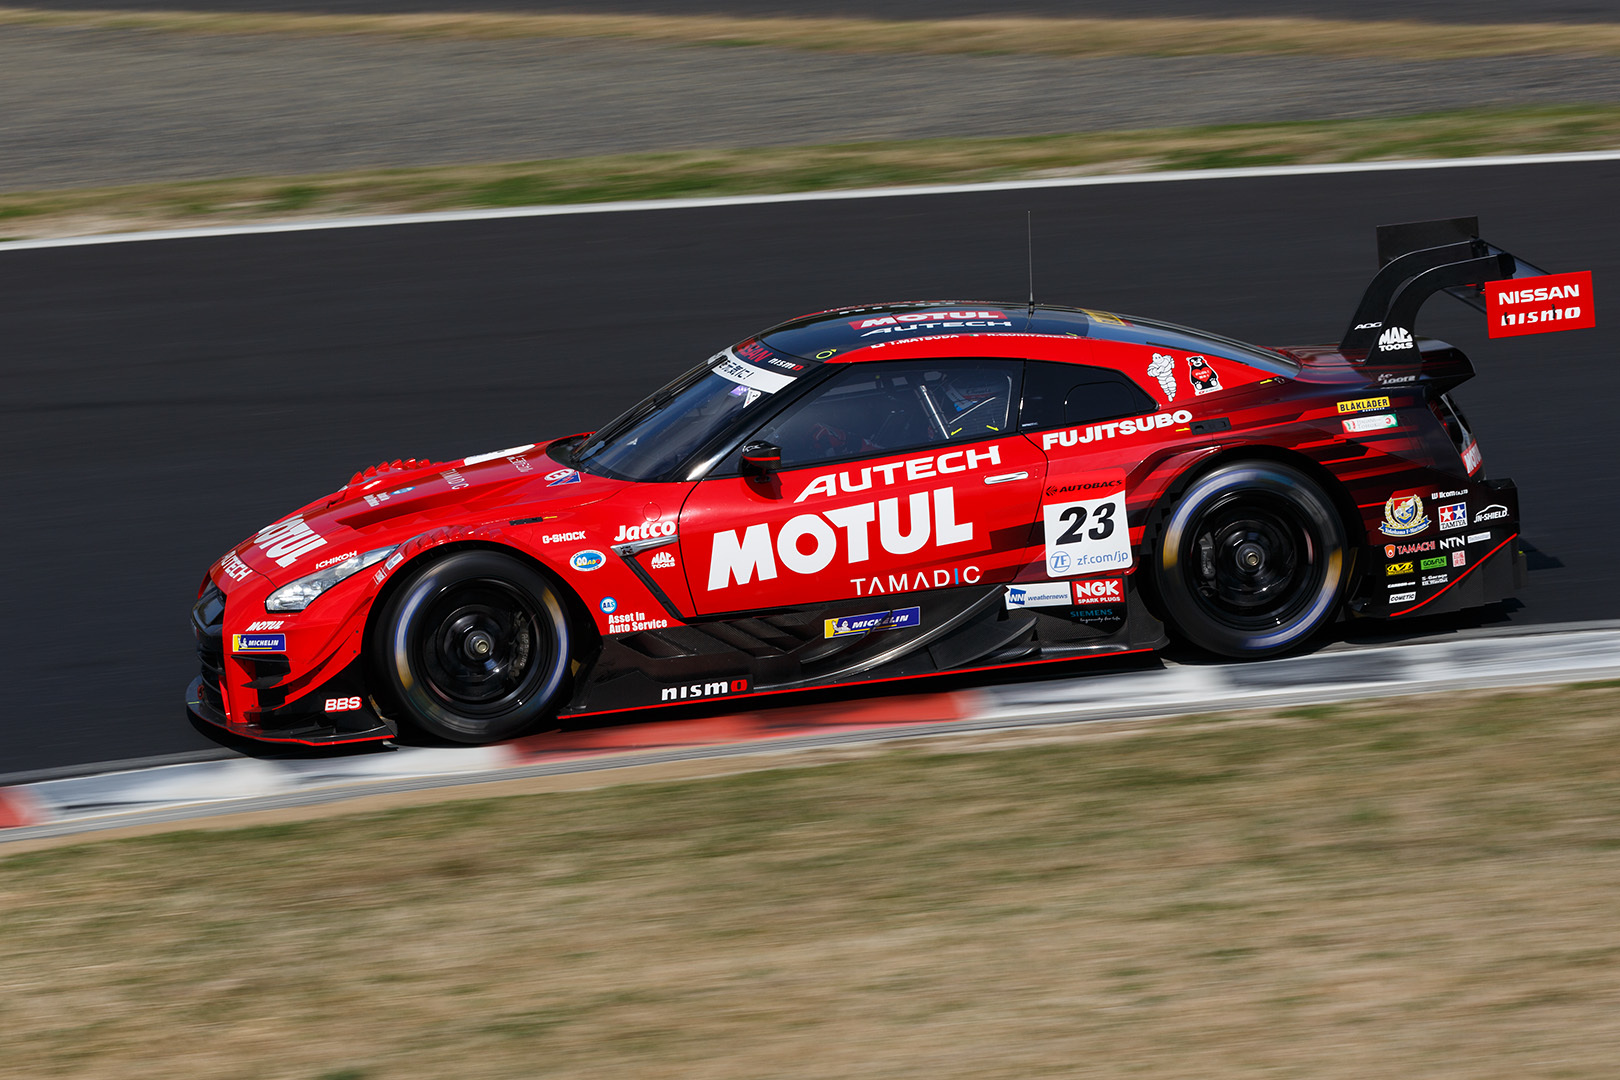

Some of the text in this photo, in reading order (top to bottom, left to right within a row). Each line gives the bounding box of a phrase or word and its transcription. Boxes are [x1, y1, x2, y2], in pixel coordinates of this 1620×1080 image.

[1498, 284, 1580, 305] NISSAN
[860, 311, 999, 328] MOTUL
[1501, 307, 1581, 326] nismo
[860, 321, 1012, 337] AUTECH
[1378, 327, 1413, 345] MAC
[1379, 342, 1413, 352] TOOLS
[1042, 409, 1193, 450] FUJITSUBO
[793, 445, 1001, 503] AUTECH
[1059, 480, 1122, 493] AUTOBACS
[614, 520, 676, 542] Jatco
[1056, 502, 1116, 545] 23
[1440, 519, 1467, 529] TAMIYA
[542, 530, 586, 544] G-SHOCK
[707, 486, 973, 592] MOTUL
[1440, 535, 1465, 549] NTN
[1397, 541, 1436, 555] TAMACHI
[315, 550, 357, 570] ICHIKOH
[1053, 551, 1129, 569] ZF zf.com/jp
[850, 566, 981, 596] TAMADIC
[1076, 580, 1119, 598] NGK
[602, 601, 615, 609] AAS
[1028, 594, 1068, 602] weathernews
[608, 613, 634, 624] Asset
[1070, 609, 1113, 618] SIEMENS
[245, 621, 284, 632] MOTUL
[609, 619, 667, 634] Auto Service
[852, 614, 909, 630] MICHELIN
[661, 679, 748, 701] nismo
[324, 696, 361, 712] BBS
